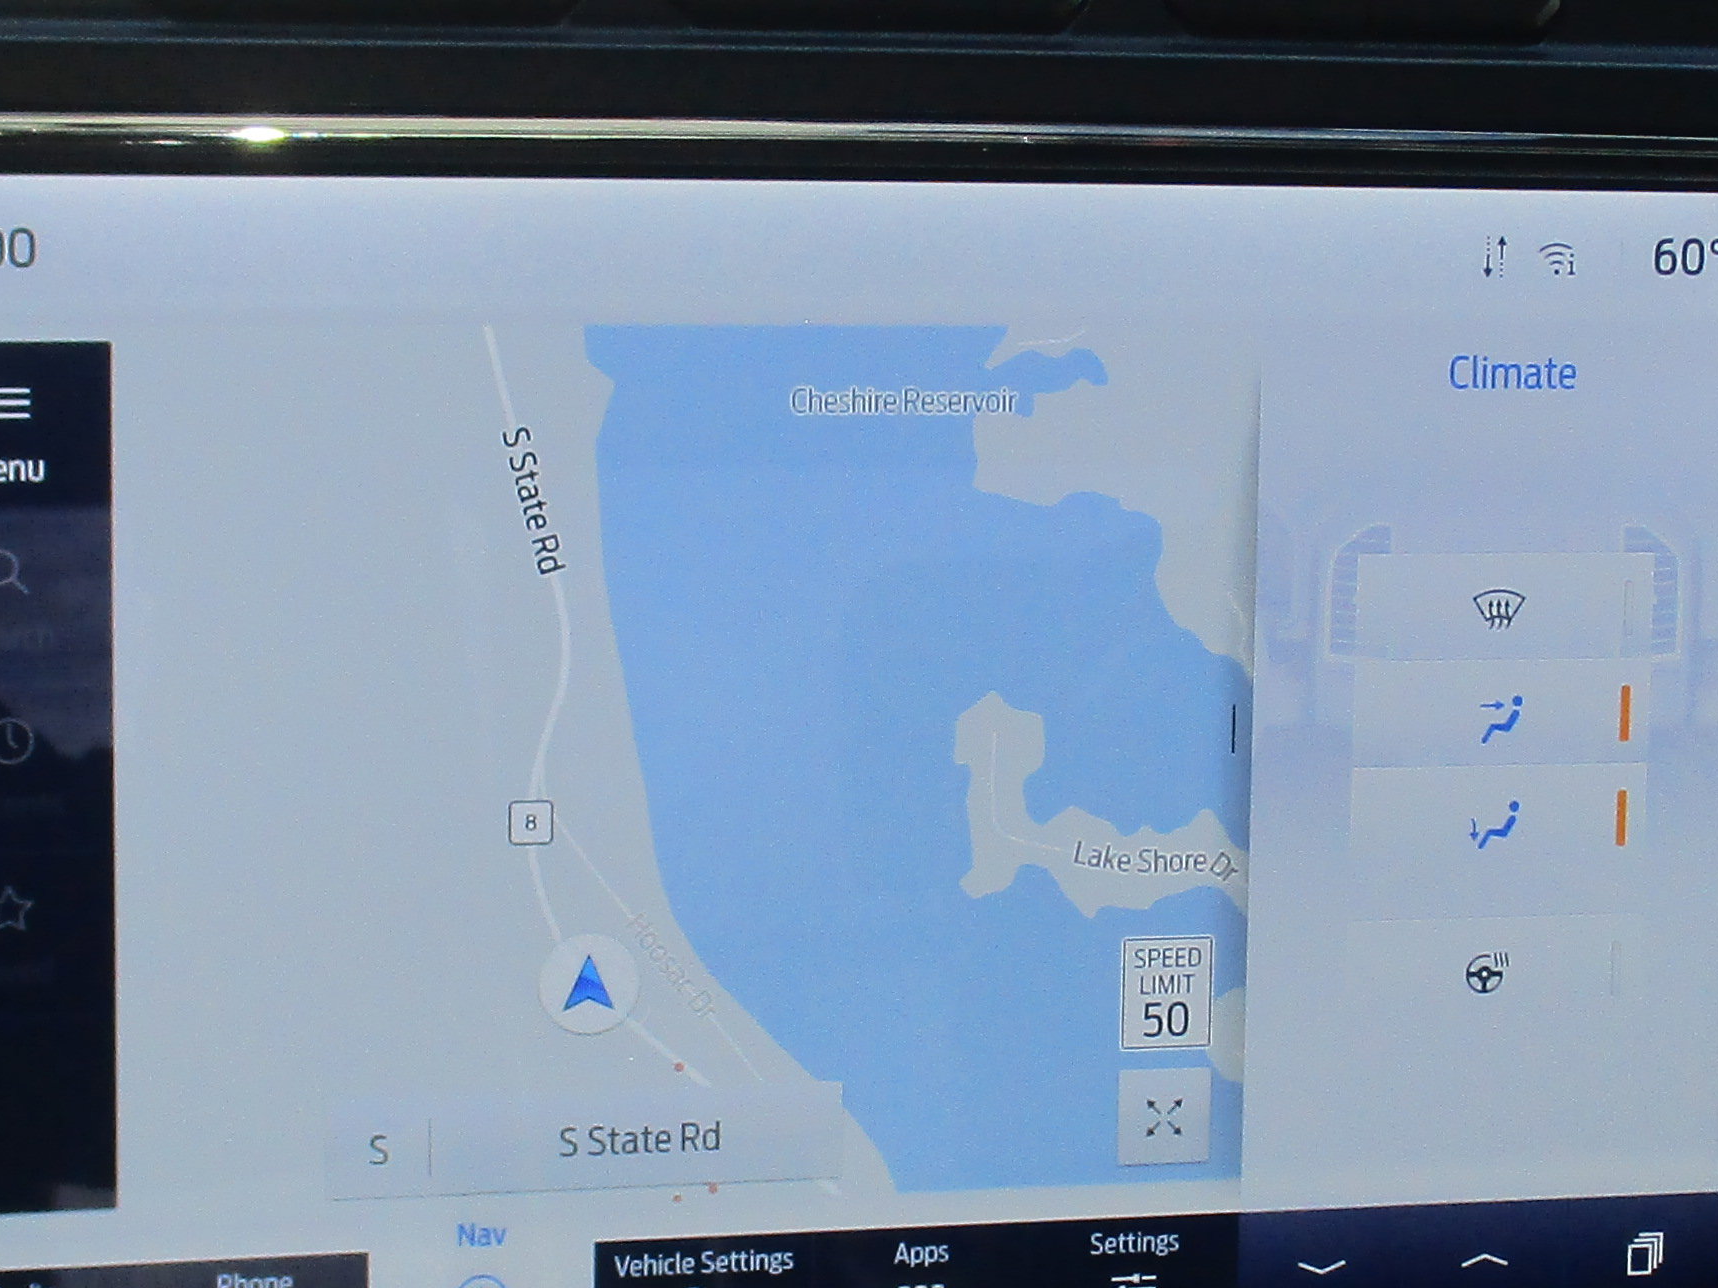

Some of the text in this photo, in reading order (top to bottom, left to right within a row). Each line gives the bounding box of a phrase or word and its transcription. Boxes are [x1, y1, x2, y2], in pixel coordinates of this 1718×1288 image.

[1448, 354, 1576, 391] Climate
[790, 386, 1017, 413] Cheshire Reservoir
[502, 425, 566, 576] S State Rd
[1073, 841, 1239, 881] Lake Shore Dr
[1134, 947, 1202, 968] SPEED
[1139, 973, 1194, 995] LIMIT
[1142, 1002, 1189, 1038] 50
[370, 1135, 388, 1166] S
[558, 1121, 721, 1157] S State Rd
[457, 1223, 506, 1247] Nav
[1090, 1229, 1180, 1258] Settings
[615, 1246, 794, 1277] Vehicle Settings
[894, 1240, 948, 1268] Apps
